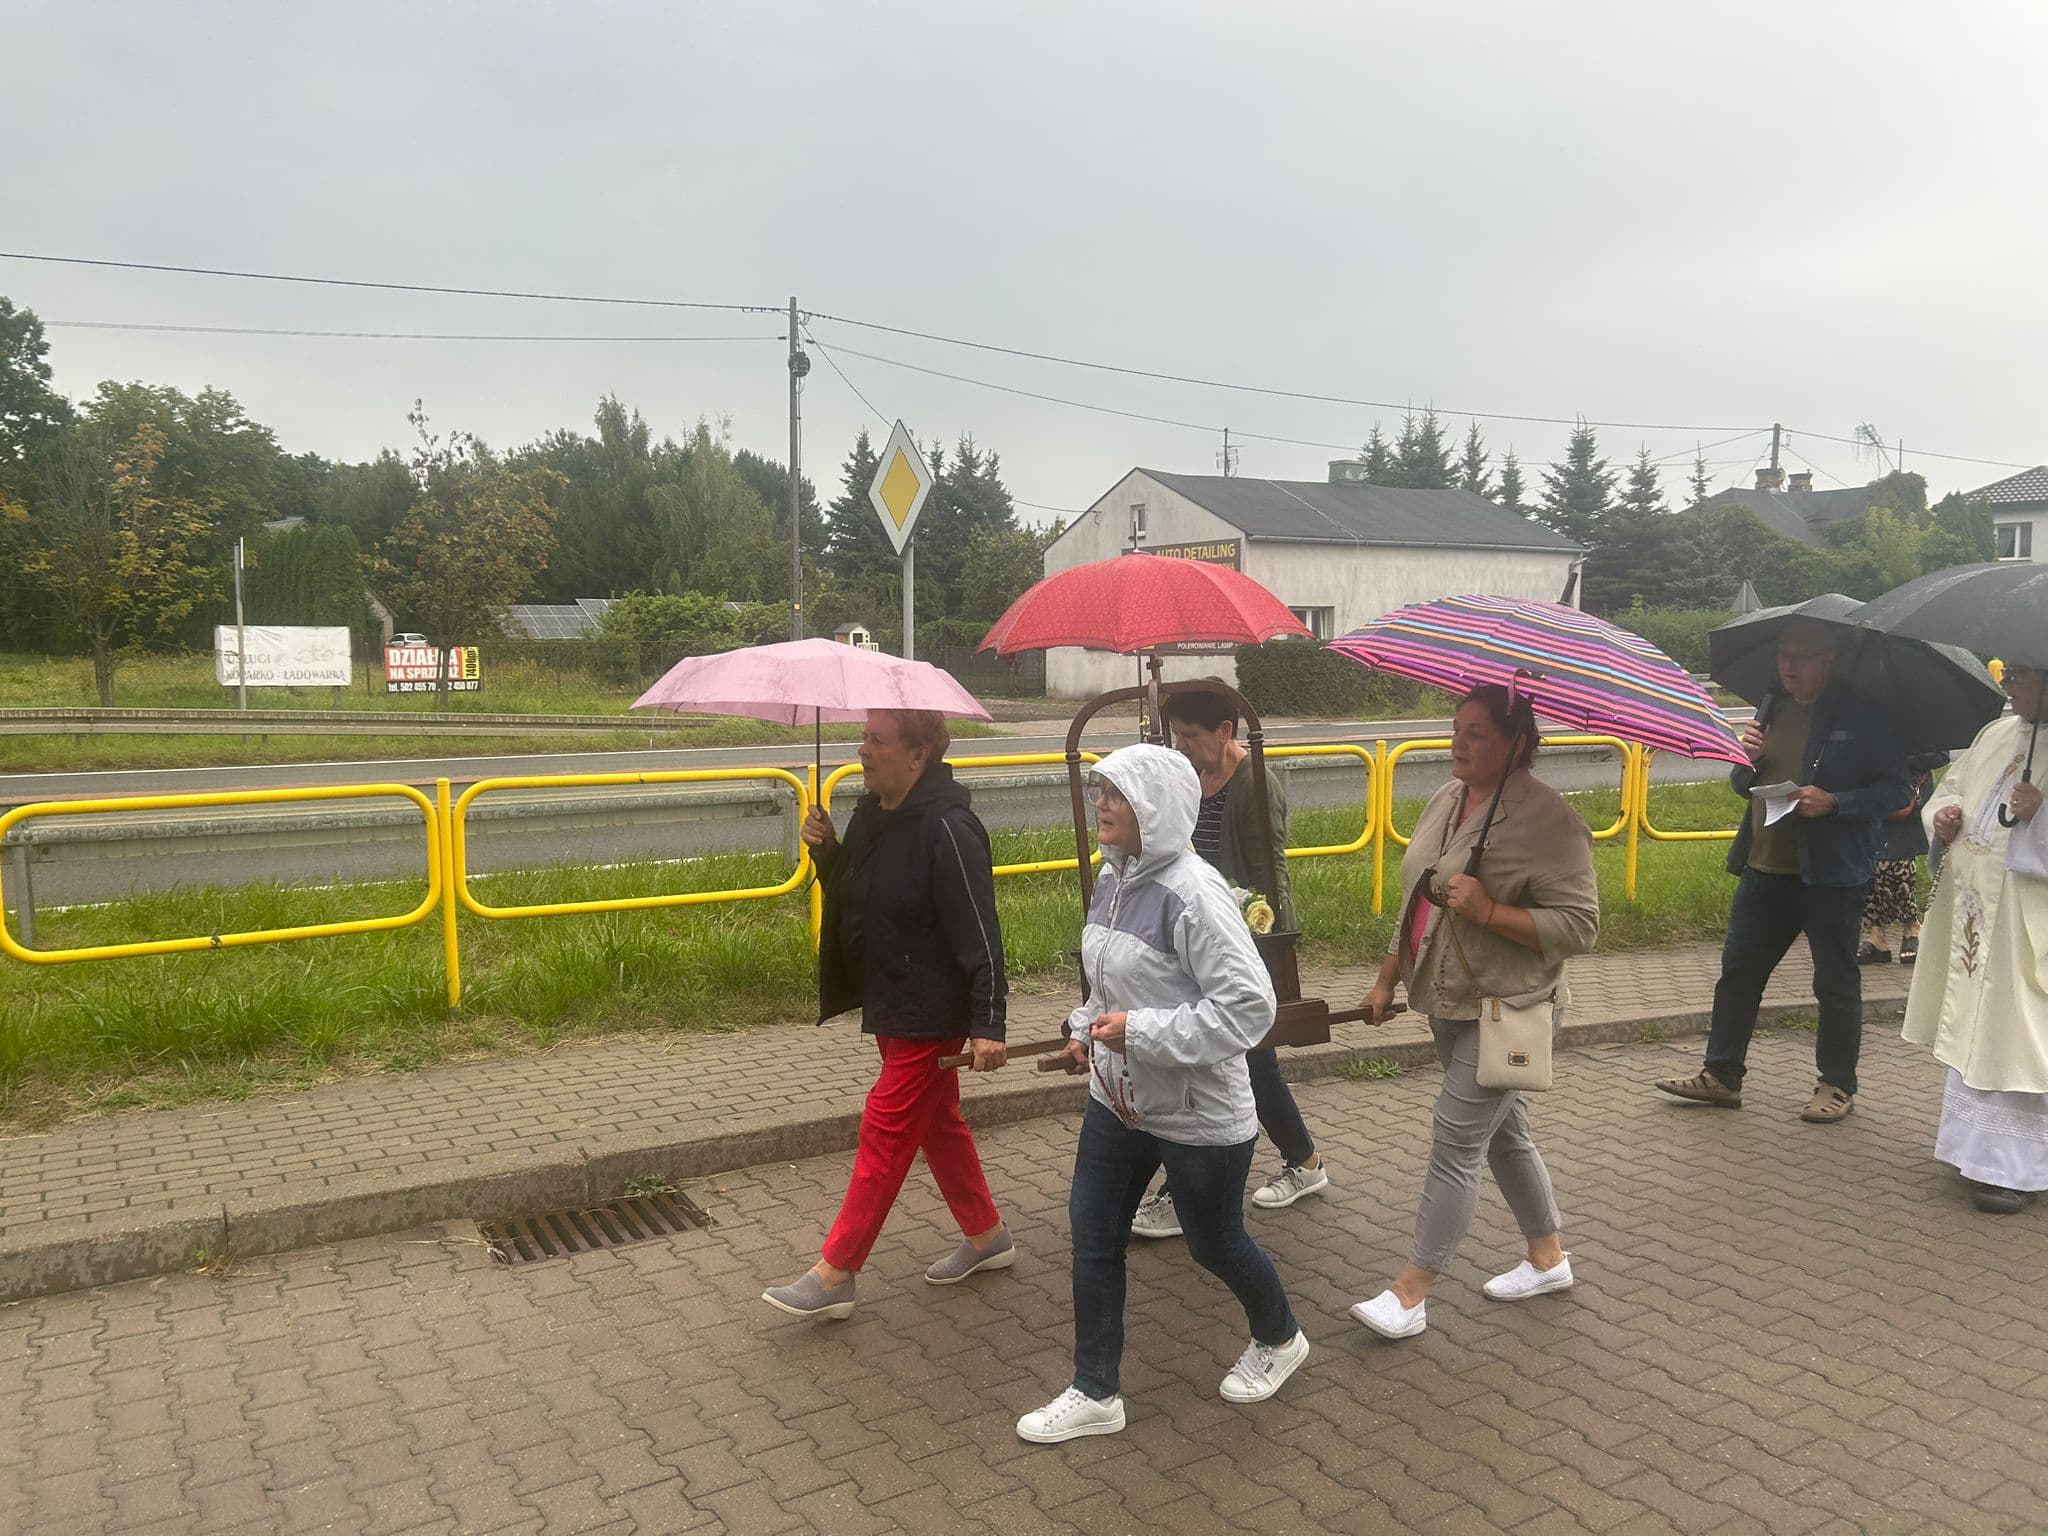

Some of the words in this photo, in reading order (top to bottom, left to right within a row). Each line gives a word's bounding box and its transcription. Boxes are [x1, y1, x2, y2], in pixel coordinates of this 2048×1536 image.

[1156, 548, 1181, 558] AUTO
[1184, 544, 1235, 560] DETAILING
[389, 648, 459, 666] DZIAŁA
[225, 669, 274, 680] KOARKO
[390, 667, 405, 680] NA
[406, 665, 459, 680] SPRZAŻ
